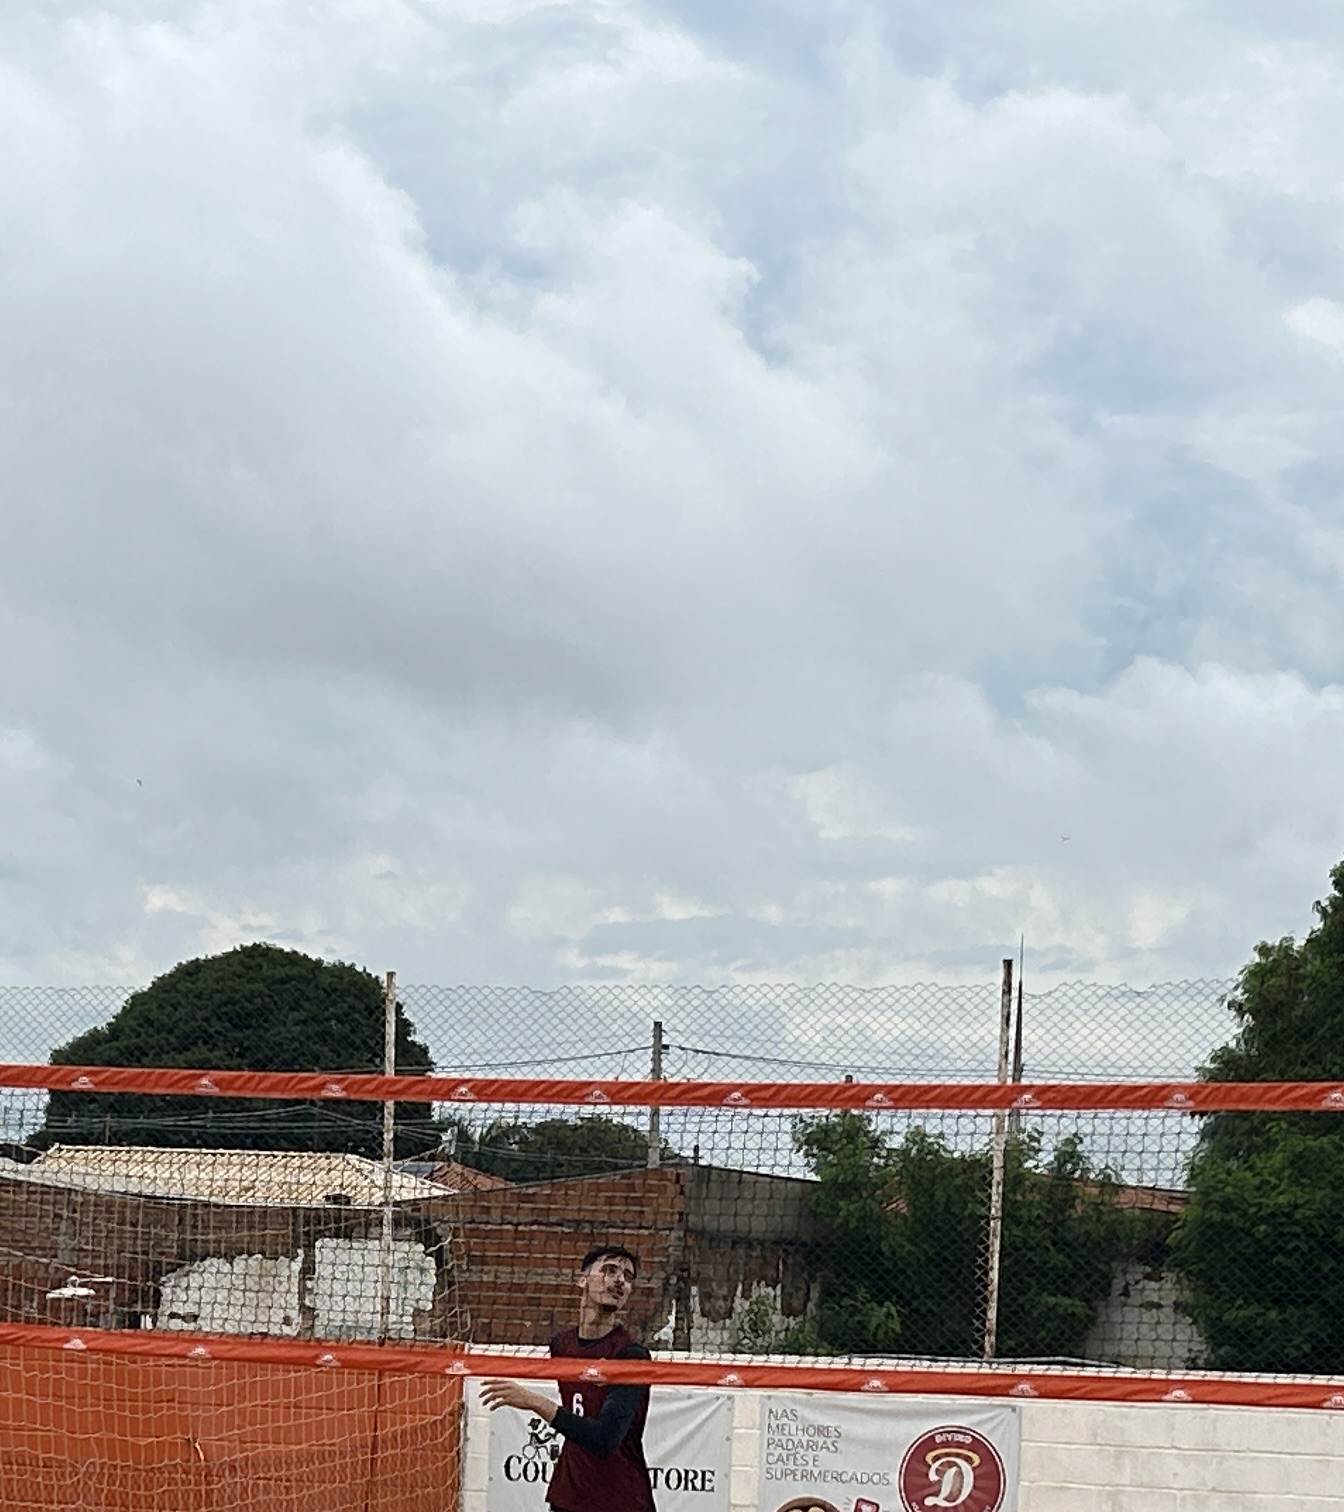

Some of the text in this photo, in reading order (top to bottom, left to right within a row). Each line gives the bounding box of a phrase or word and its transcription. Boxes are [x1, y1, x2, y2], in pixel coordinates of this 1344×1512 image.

[572, 1392, 585, 1418] 6
[767, 1407, 800, 1422] NAS
[767, 1422, 843, 1439] MELHORES
[812, 1454, 821, 1468] E
[646, 1466, 716, 1493] TORE
